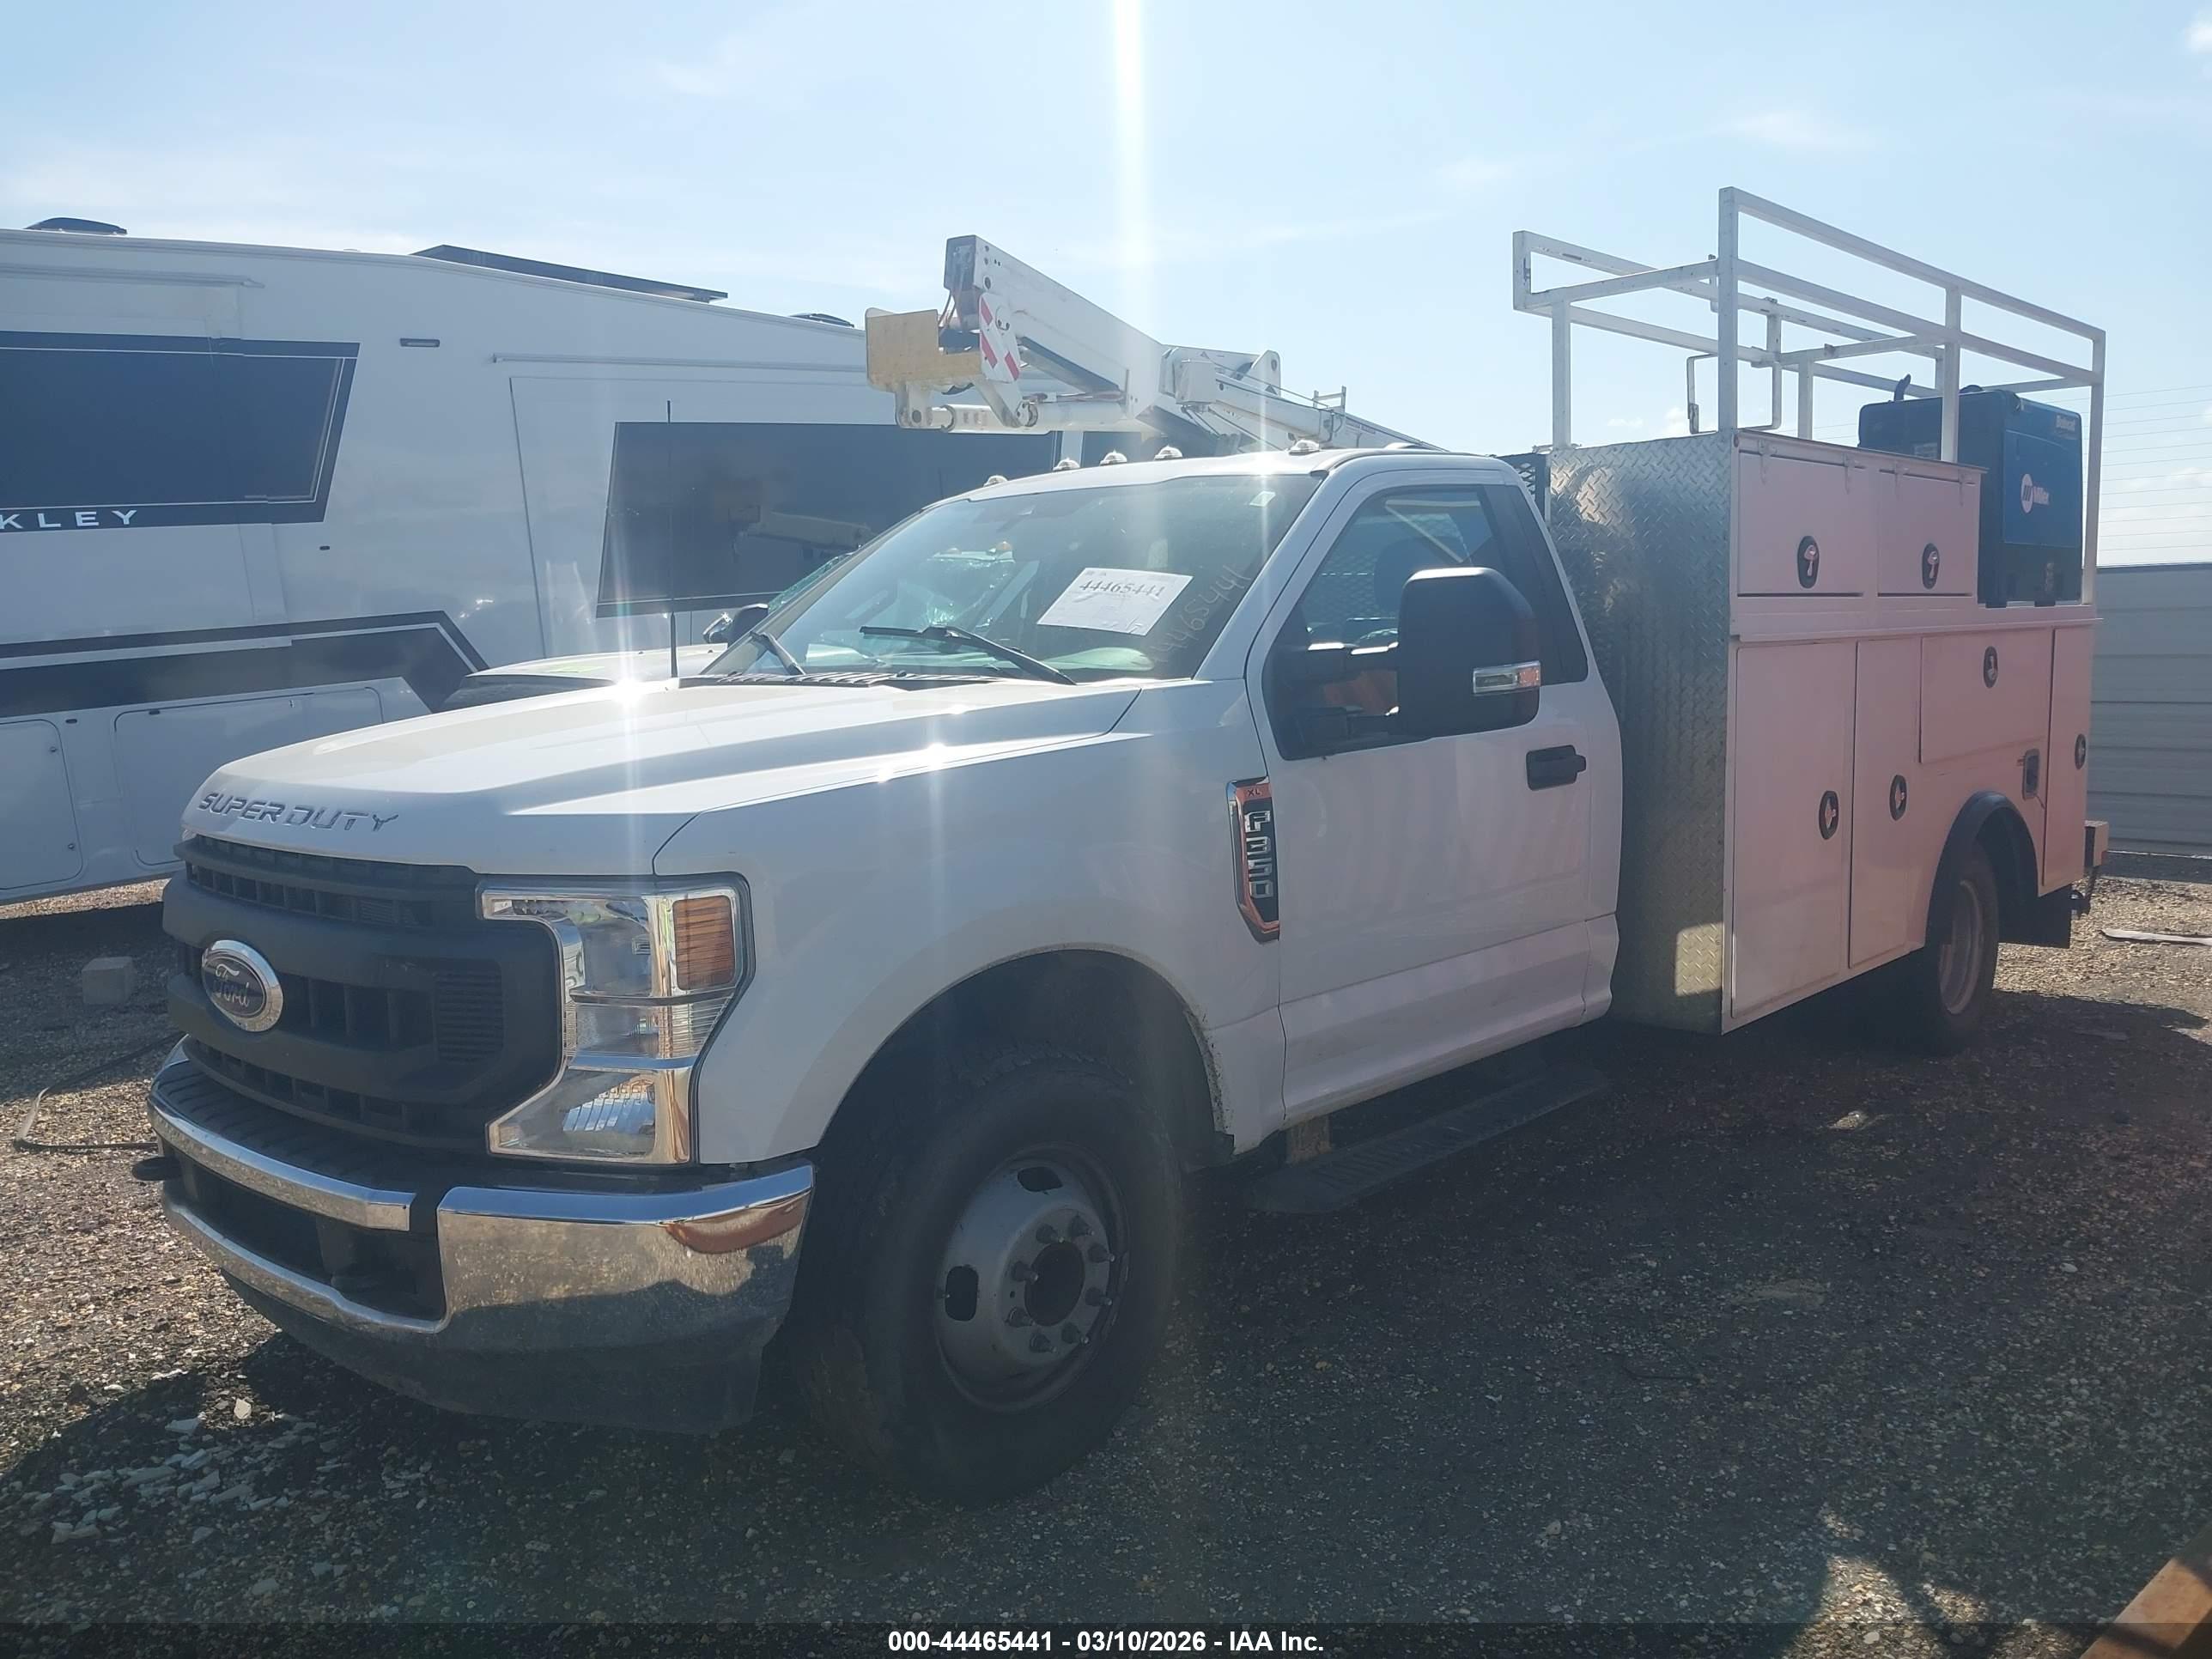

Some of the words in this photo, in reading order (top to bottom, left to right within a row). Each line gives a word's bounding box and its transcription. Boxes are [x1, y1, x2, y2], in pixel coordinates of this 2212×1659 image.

[1079, 580, 1166, 599] 44465441
[1247, 788, 1261, 797] XL
[198, 792, 286, 824] SUPER
[283, 806, 399, 832] DUTY
[212, 963, 250, 1008] Ford
